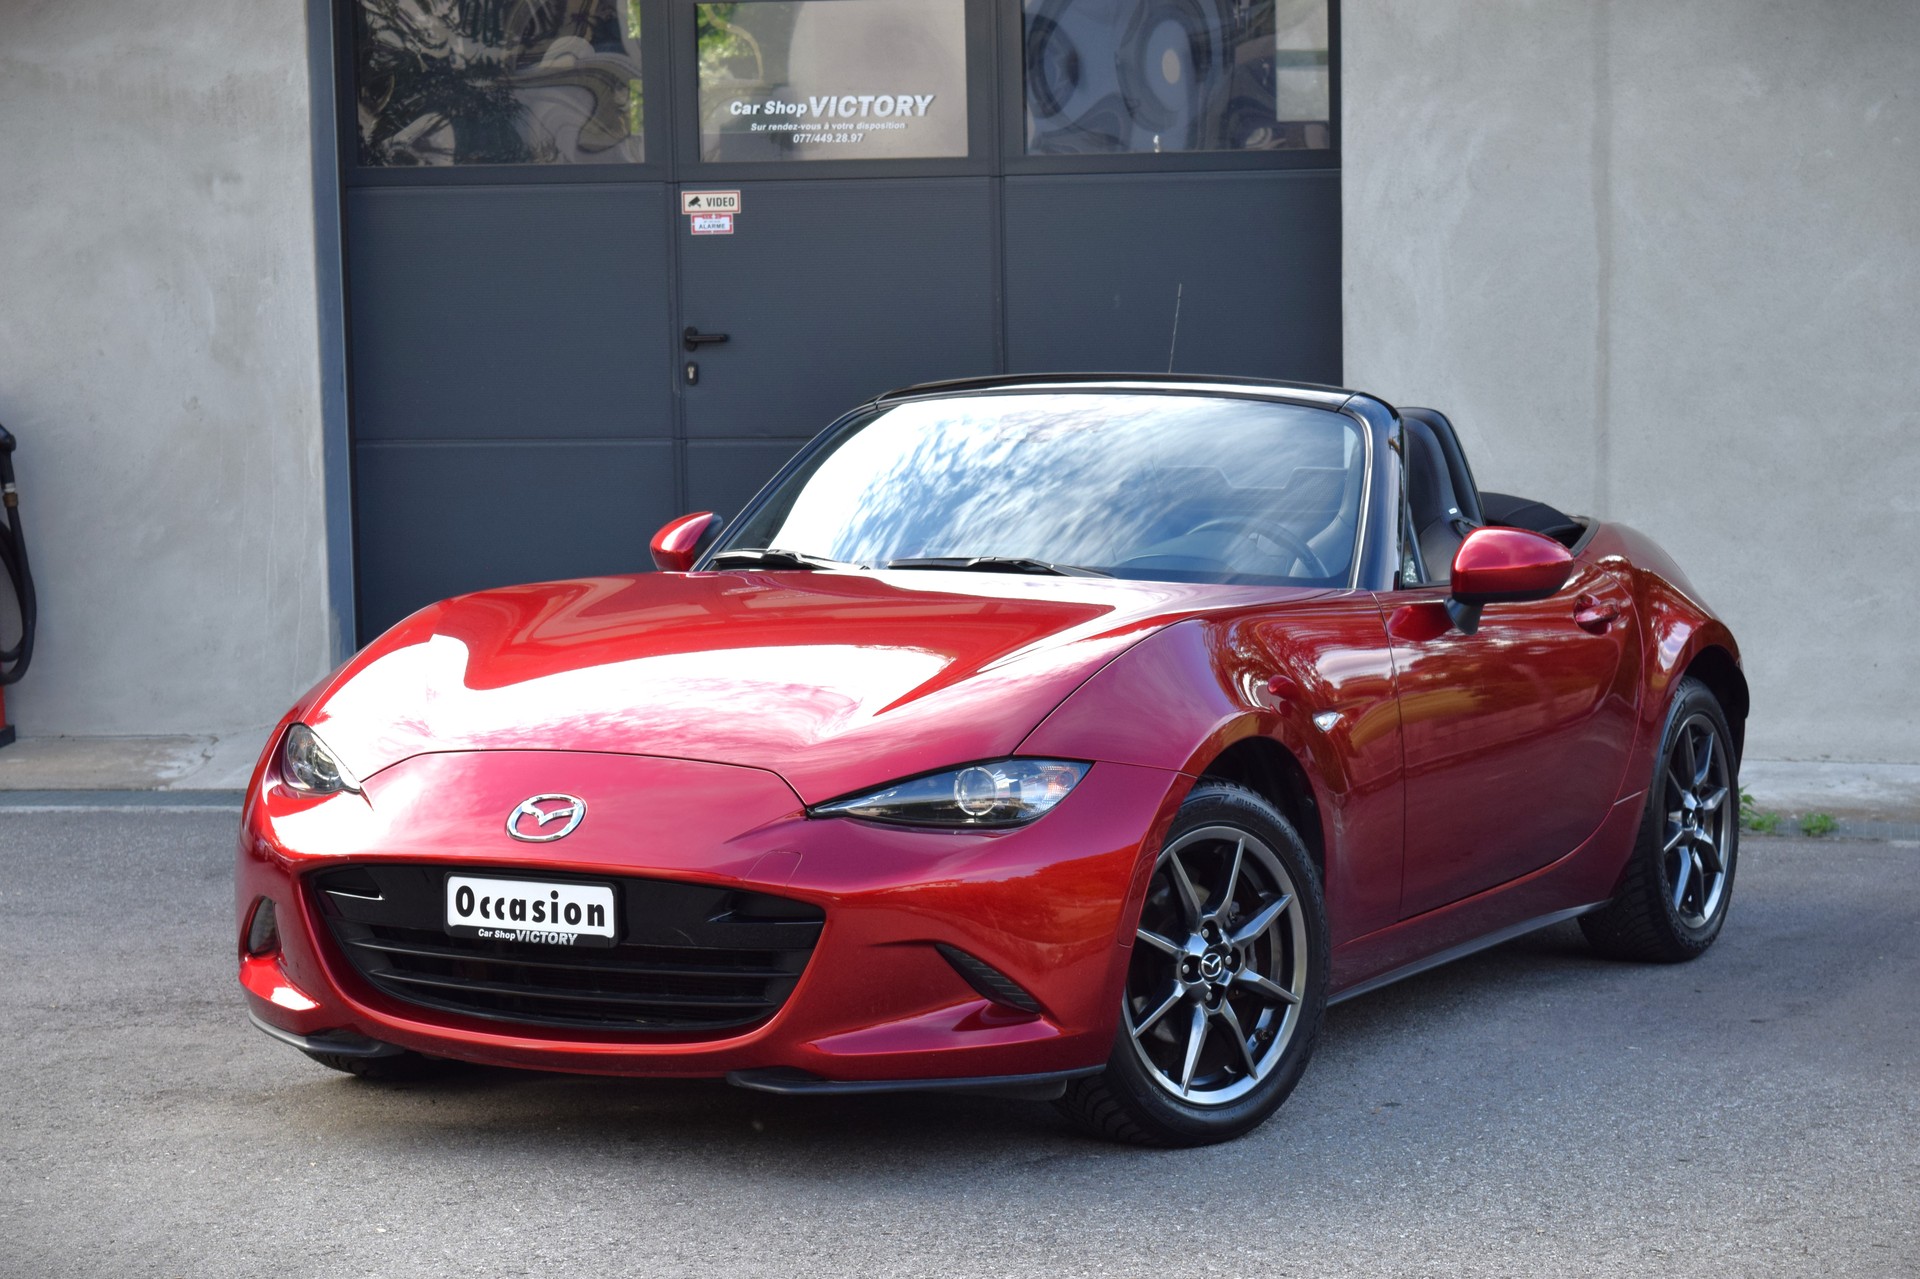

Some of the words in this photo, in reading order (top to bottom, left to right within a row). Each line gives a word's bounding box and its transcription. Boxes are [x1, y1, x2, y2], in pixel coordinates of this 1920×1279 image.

[730, 101, 760, 115] Car
[764, 101, 808, 117] Shop
[809, 95, 934, 118] VICTORY
[751, 122, 766, 131] Sur
[768, 122, 821, 131] rendez-vous
[824, 121, 830, 130] à
[832, 122, 854, 130] votre
[856, 121, 905, 132] disposition
[793, 134, 863, 143] 077/449.28.97
[706, 197, 735, 207] VIDEO
[455, 885, 605, 927] Occasion
[478, 928, 493, 938] Car
[494, 929, 516, 941] Shop
[516, 929, 578, 945] VICTORY
